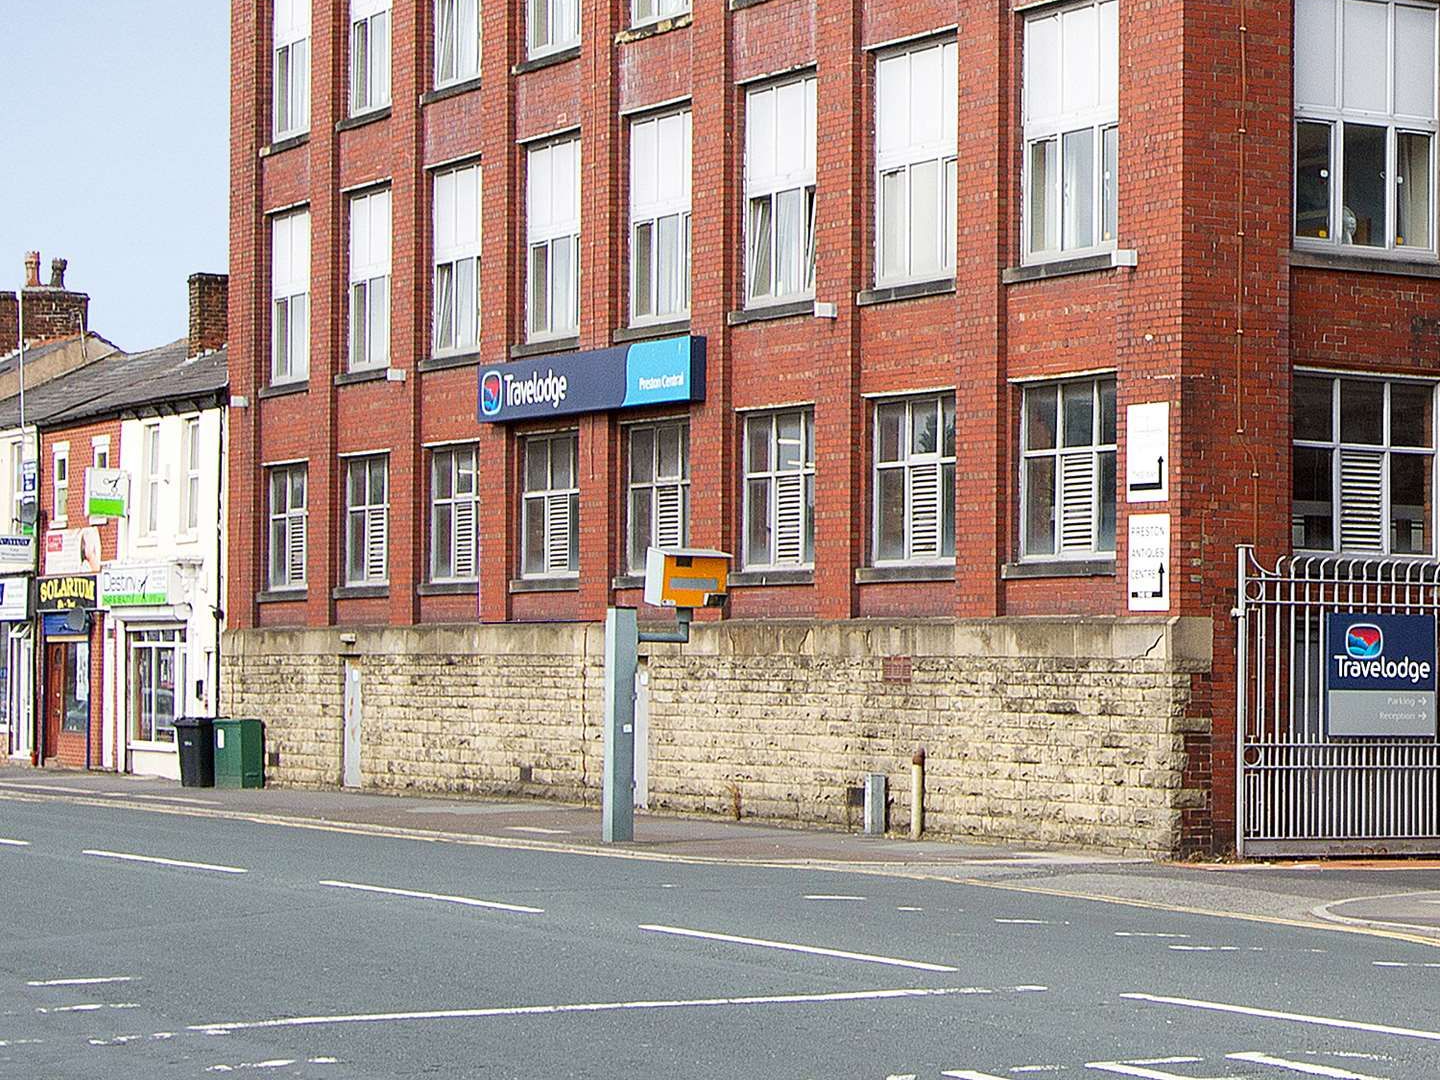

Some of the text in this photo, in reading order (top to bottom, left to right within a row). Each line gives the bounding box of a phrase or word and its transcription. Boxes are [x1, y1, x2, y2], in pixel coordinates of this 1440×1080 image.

[504, 369, 567, 408] Travelodge
[1131, 526, 1167, 537] PRESTON
[1131, 547, 1165, 558] ANTIQUES
[40, 577, 95, 603] SOLARIUM
[1334, 655, 1431, 684] Travelodge
[1379, 710, 1416, 722] Reception
